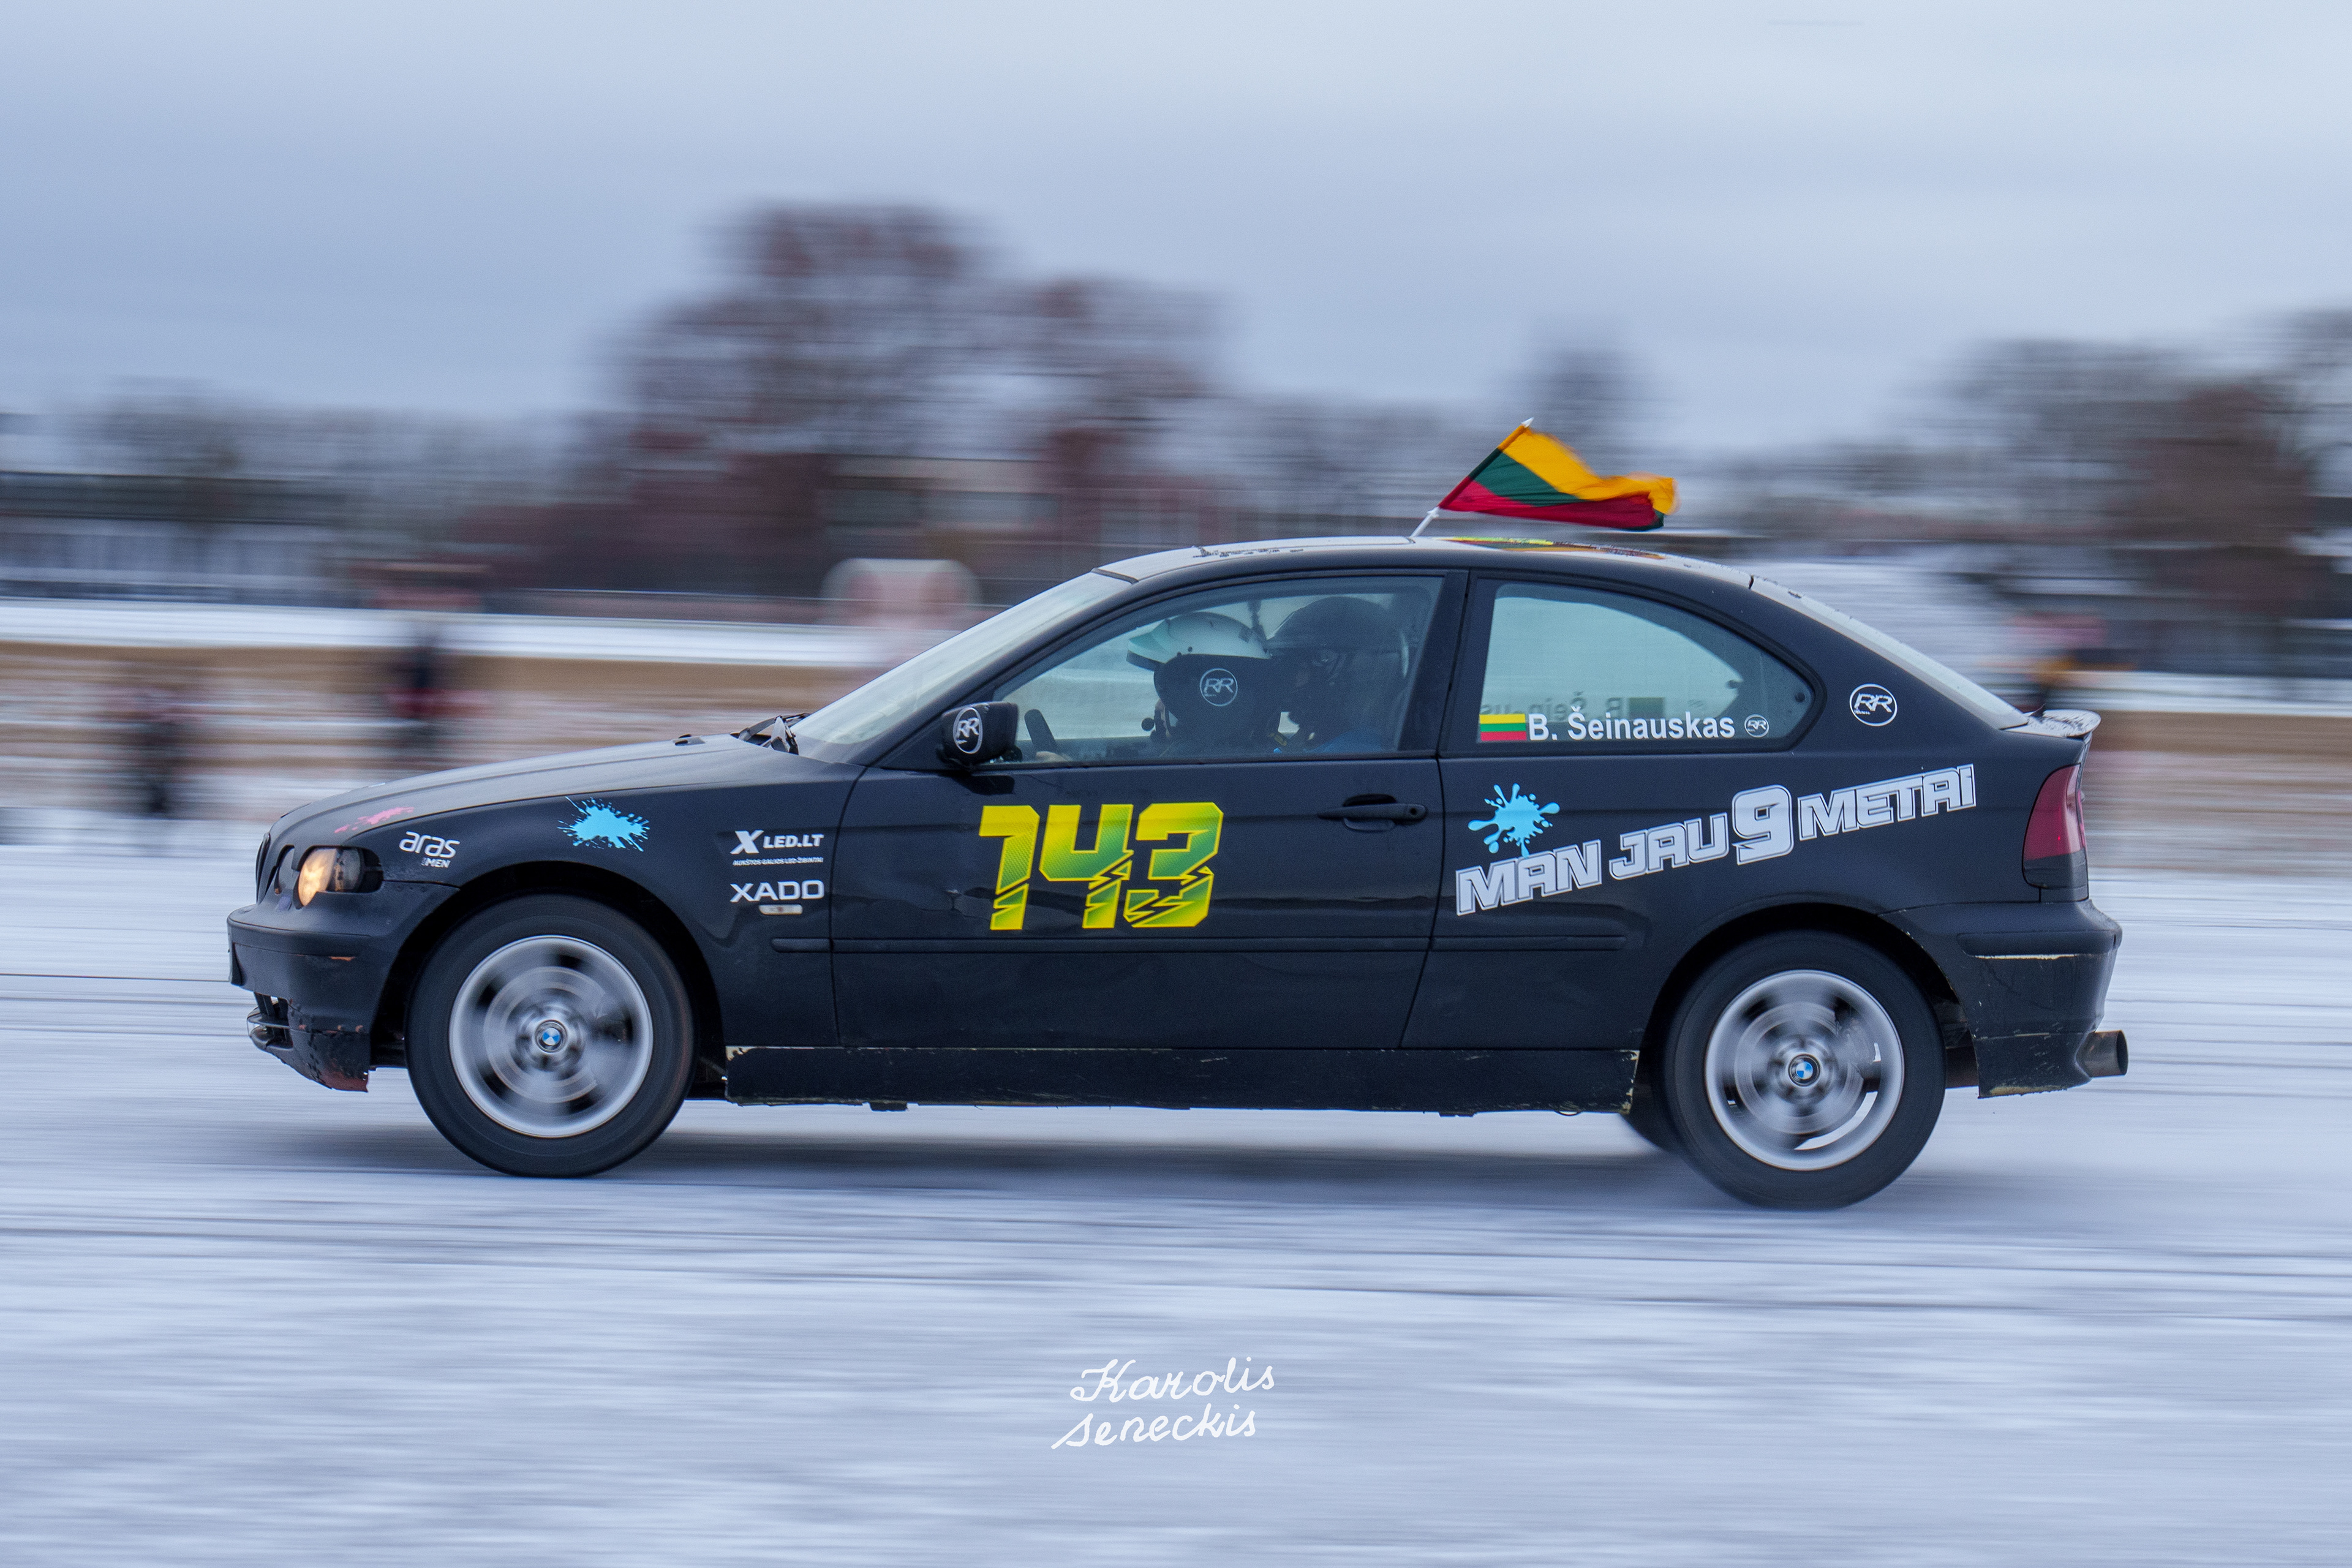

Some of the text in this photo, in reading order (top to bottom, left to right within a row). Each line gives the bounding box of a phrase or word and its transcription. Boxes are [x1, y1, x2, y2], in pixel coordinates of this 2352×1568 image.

[1528, 706, 1736, 741] B. Šeinauskas
[399, 831, 461, 859] aras
[1455, 764, 1977, 916] MAN JAU 9 METAI
[729, 880, 825, 903] XADO
